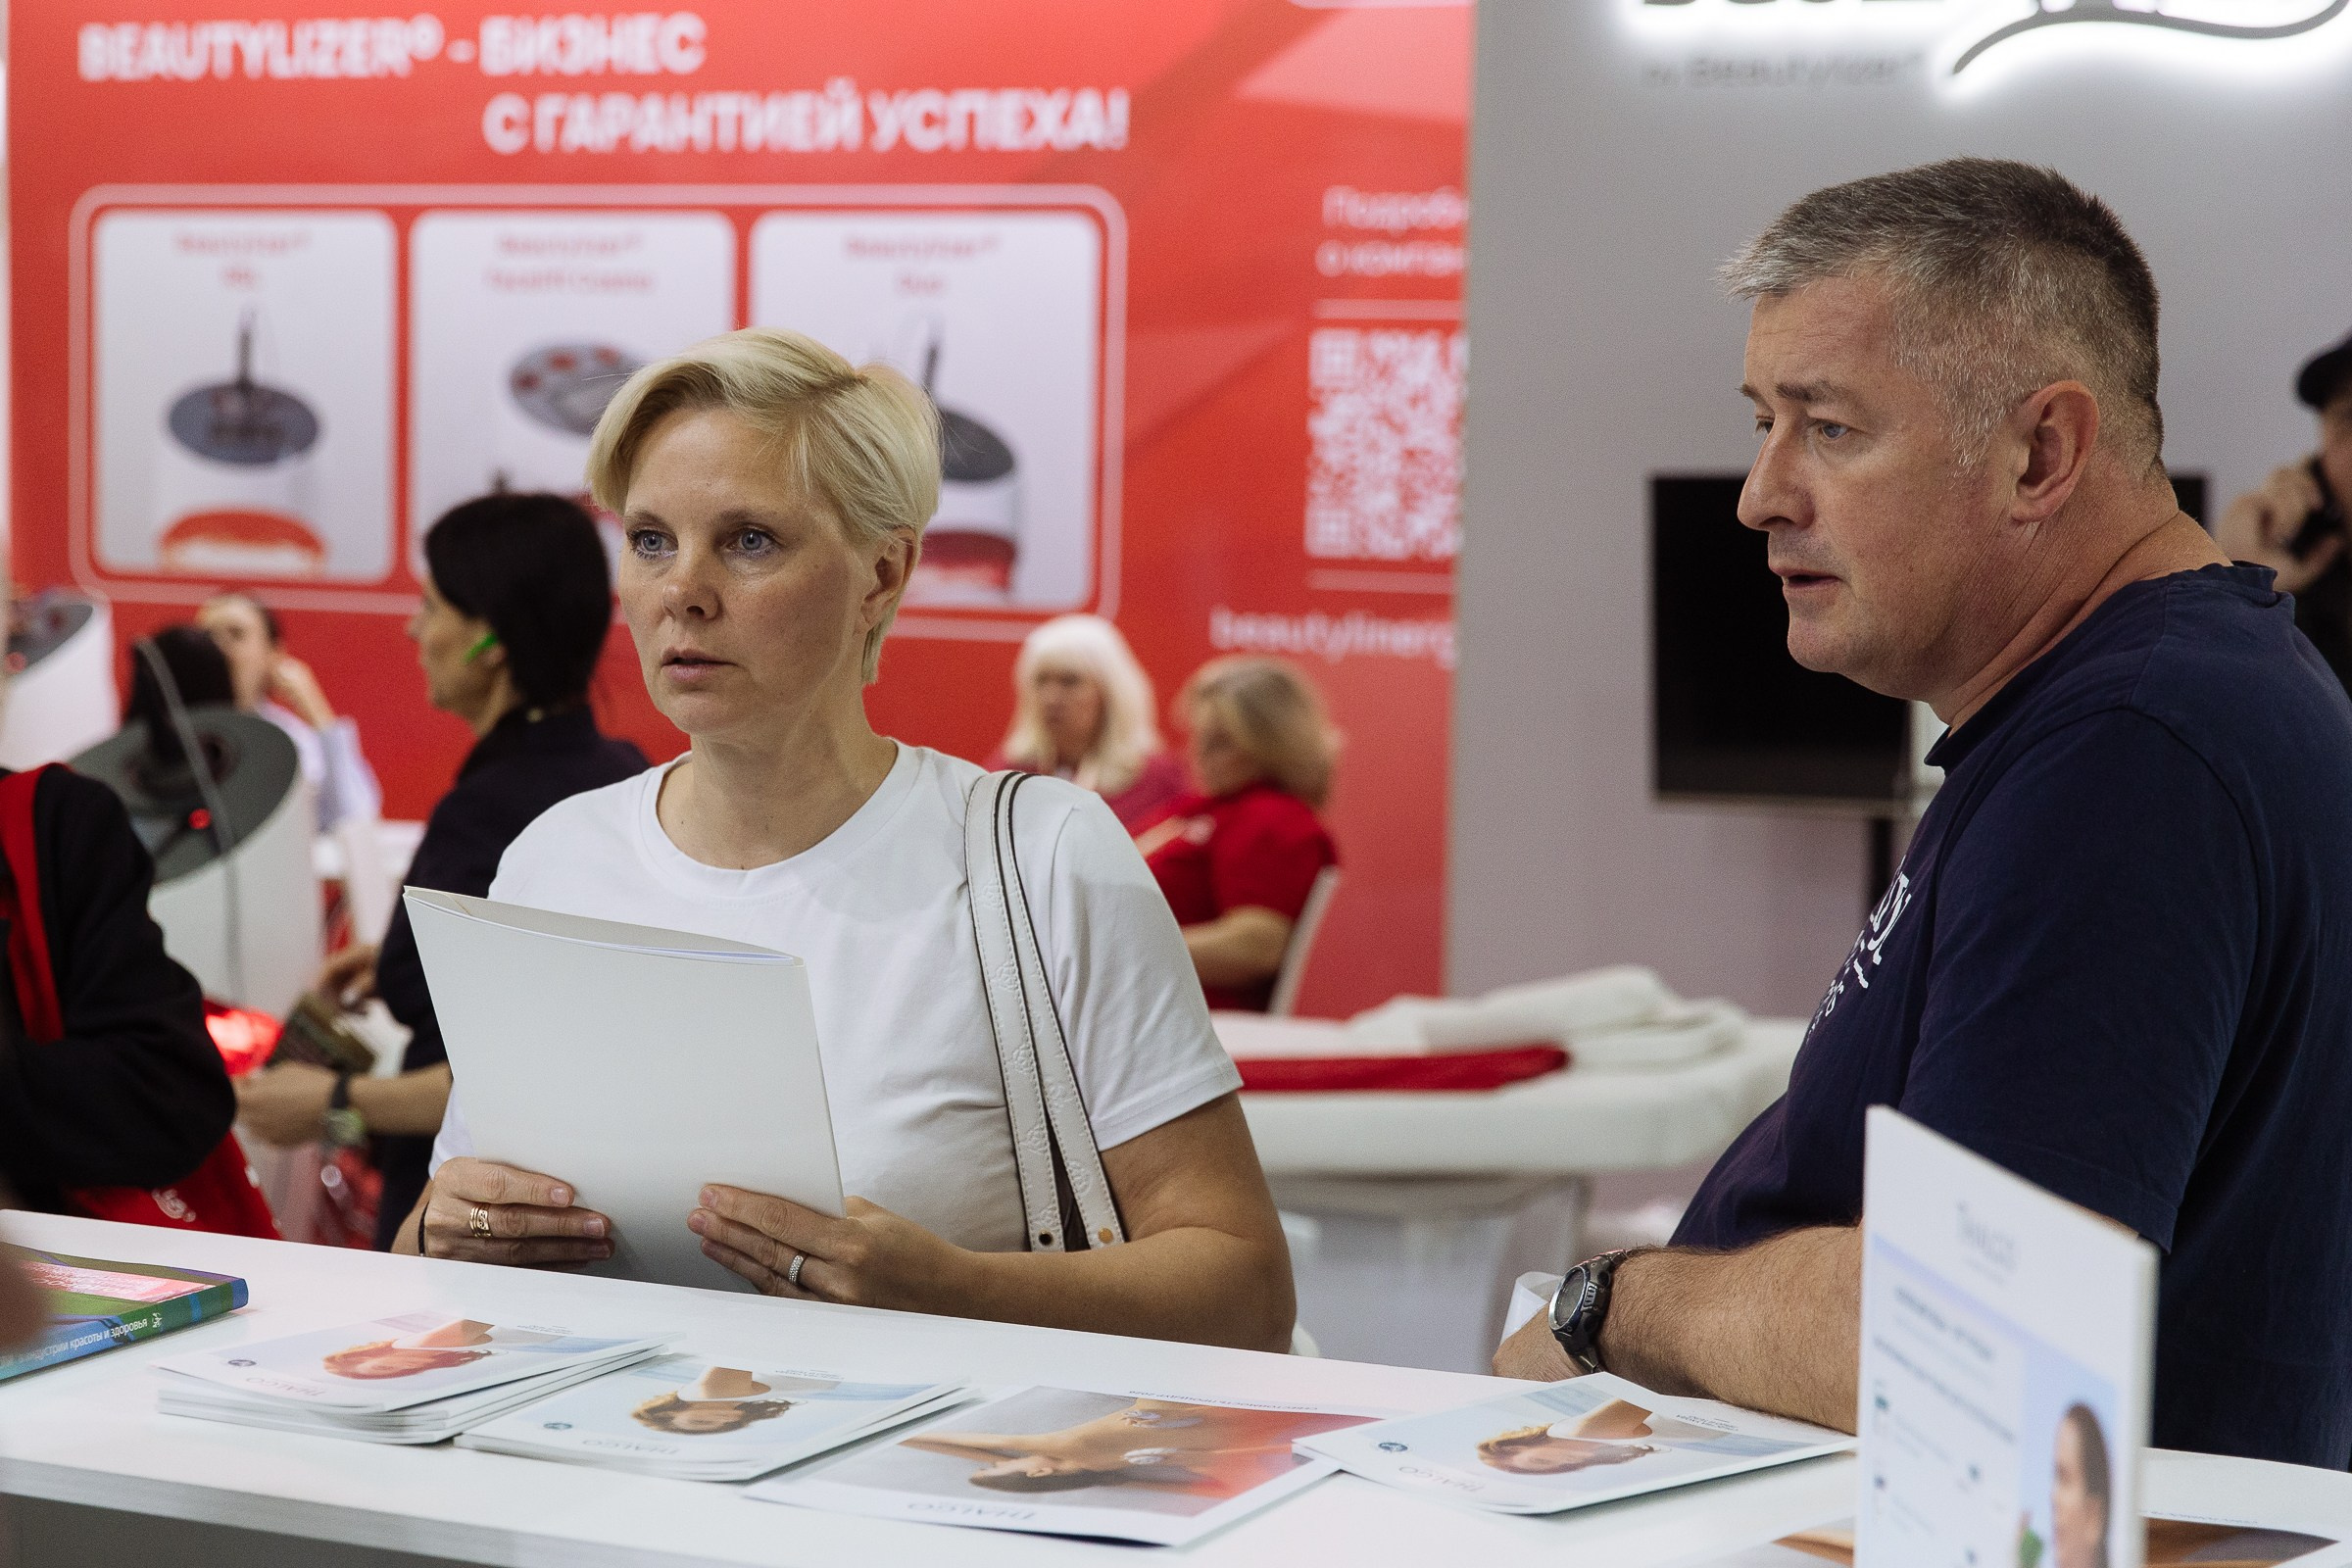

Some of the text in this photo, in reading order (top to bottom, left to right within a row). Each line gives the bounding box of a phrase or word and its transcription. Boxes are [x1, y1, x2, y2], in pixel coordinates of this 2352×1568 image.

[479, 12, 707, 75] БИЗНЕС
[482, 76, 1130, 155] С ГАРАНТИЕЙ УСПЕХА!
[70, 1330, 104, 1352] красоты
[110, 1318, 148, 1339] здоровья
